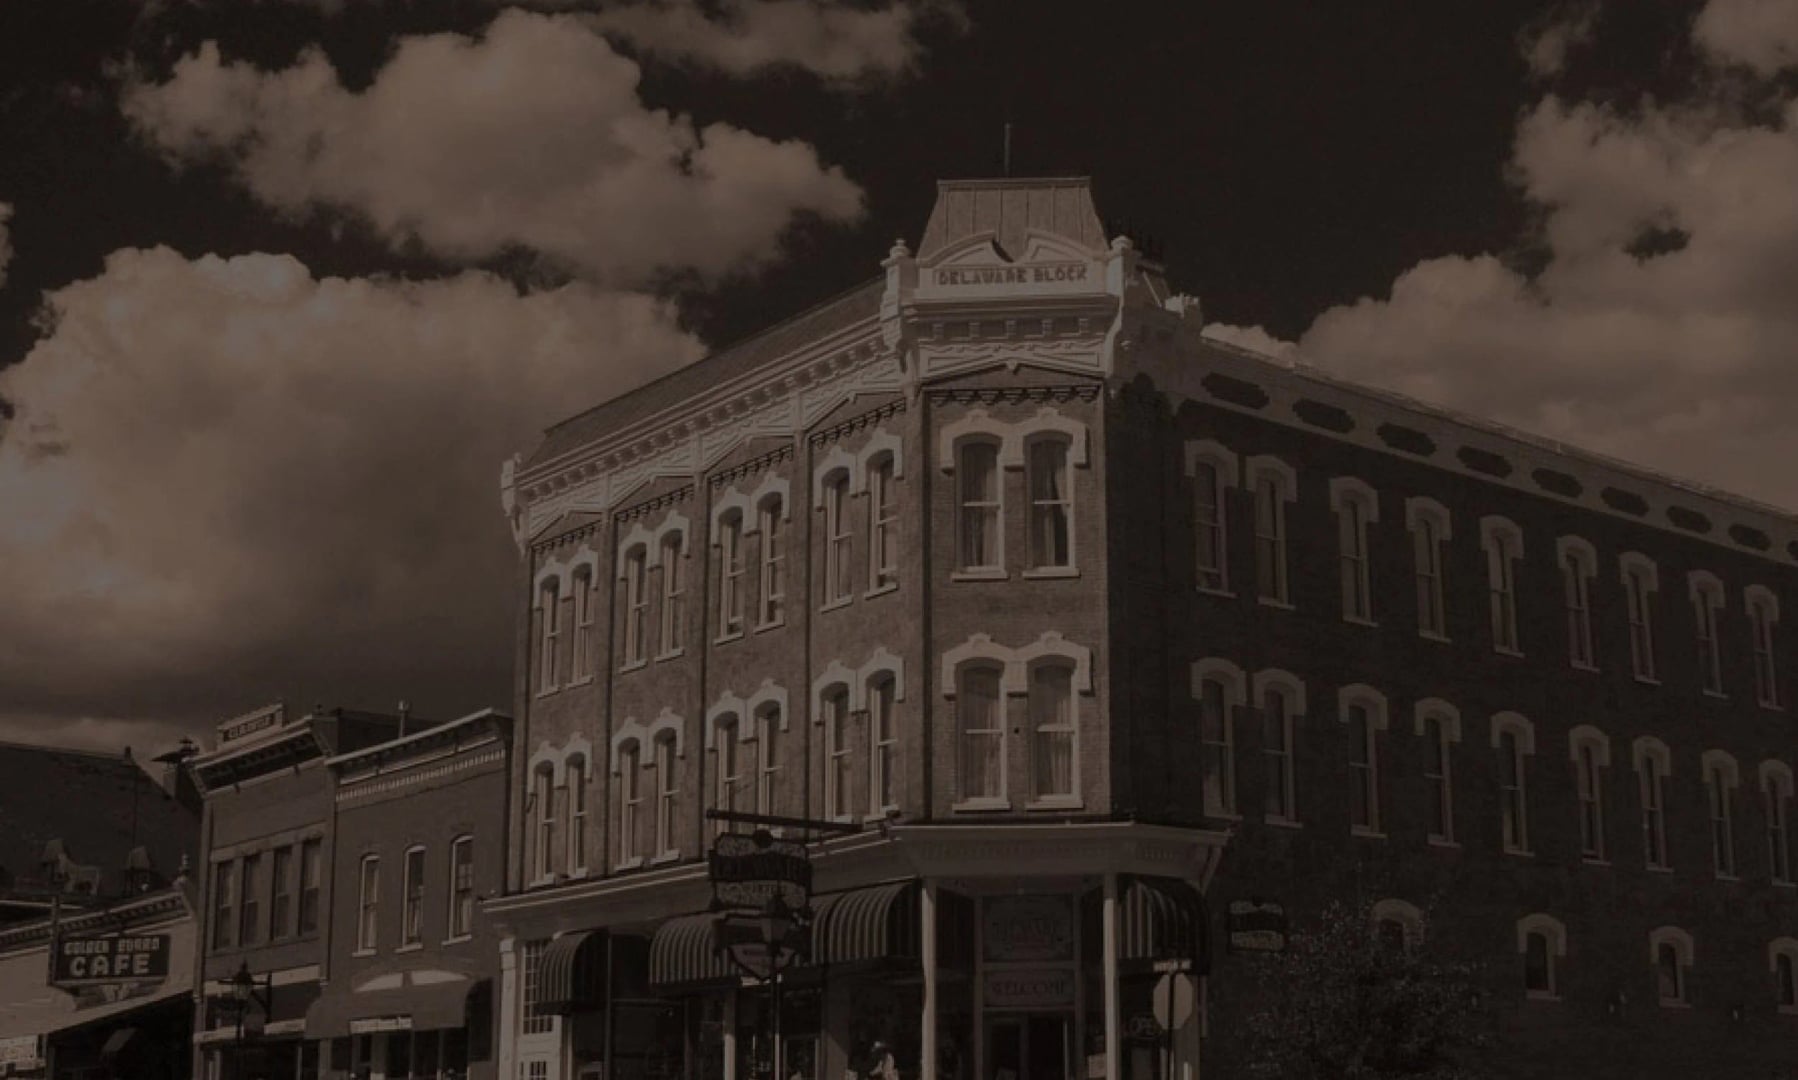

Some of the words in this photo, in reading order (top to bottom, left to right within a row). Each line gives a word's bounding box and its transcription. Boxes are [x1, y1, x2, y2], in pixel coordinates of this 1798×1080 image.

[939, 268, 1027, 285] DELAWARE
[1034, 264, 1088, 282] BLOCK
[69, 953, 151, 977] CAFE
